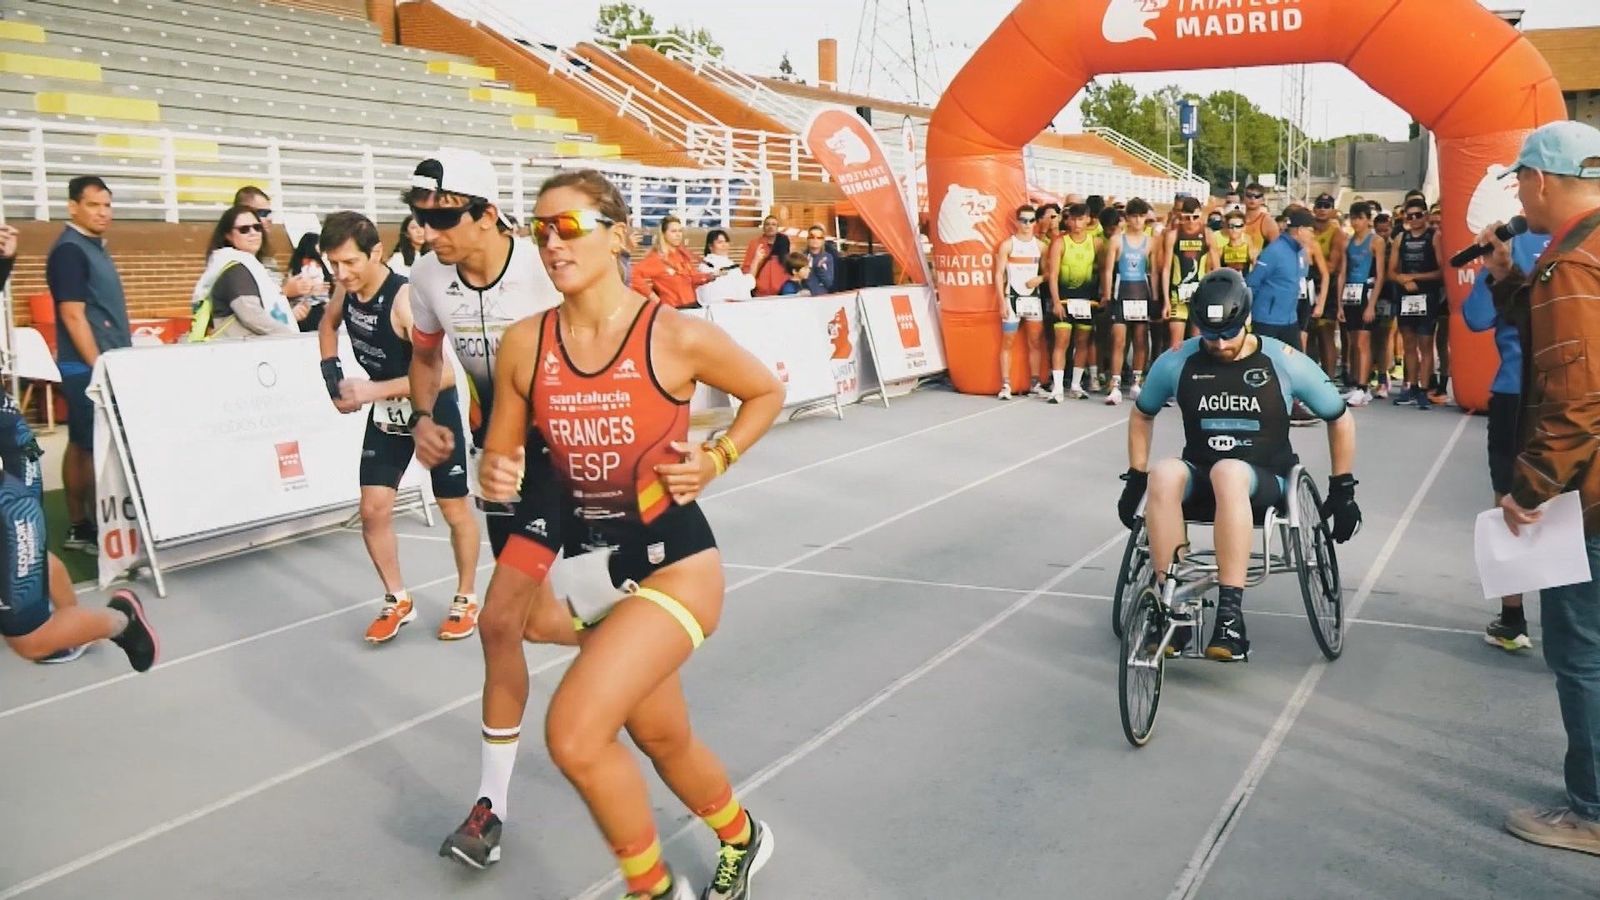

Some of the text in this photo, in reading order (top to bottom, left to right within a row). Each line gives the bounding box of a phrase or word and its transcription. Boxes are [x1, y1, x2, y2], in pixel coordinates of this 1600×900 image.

[1176, 8, 1302, 38] MADRID
[936, 253, 993, 268] TRIATLO
[937, 270, 993, 286] MADRI
[1198, 392, 1262, 412] AGÜERA
[549, 416, 636, 447] FRANCES
[568, 452, 621, 481] ESP
